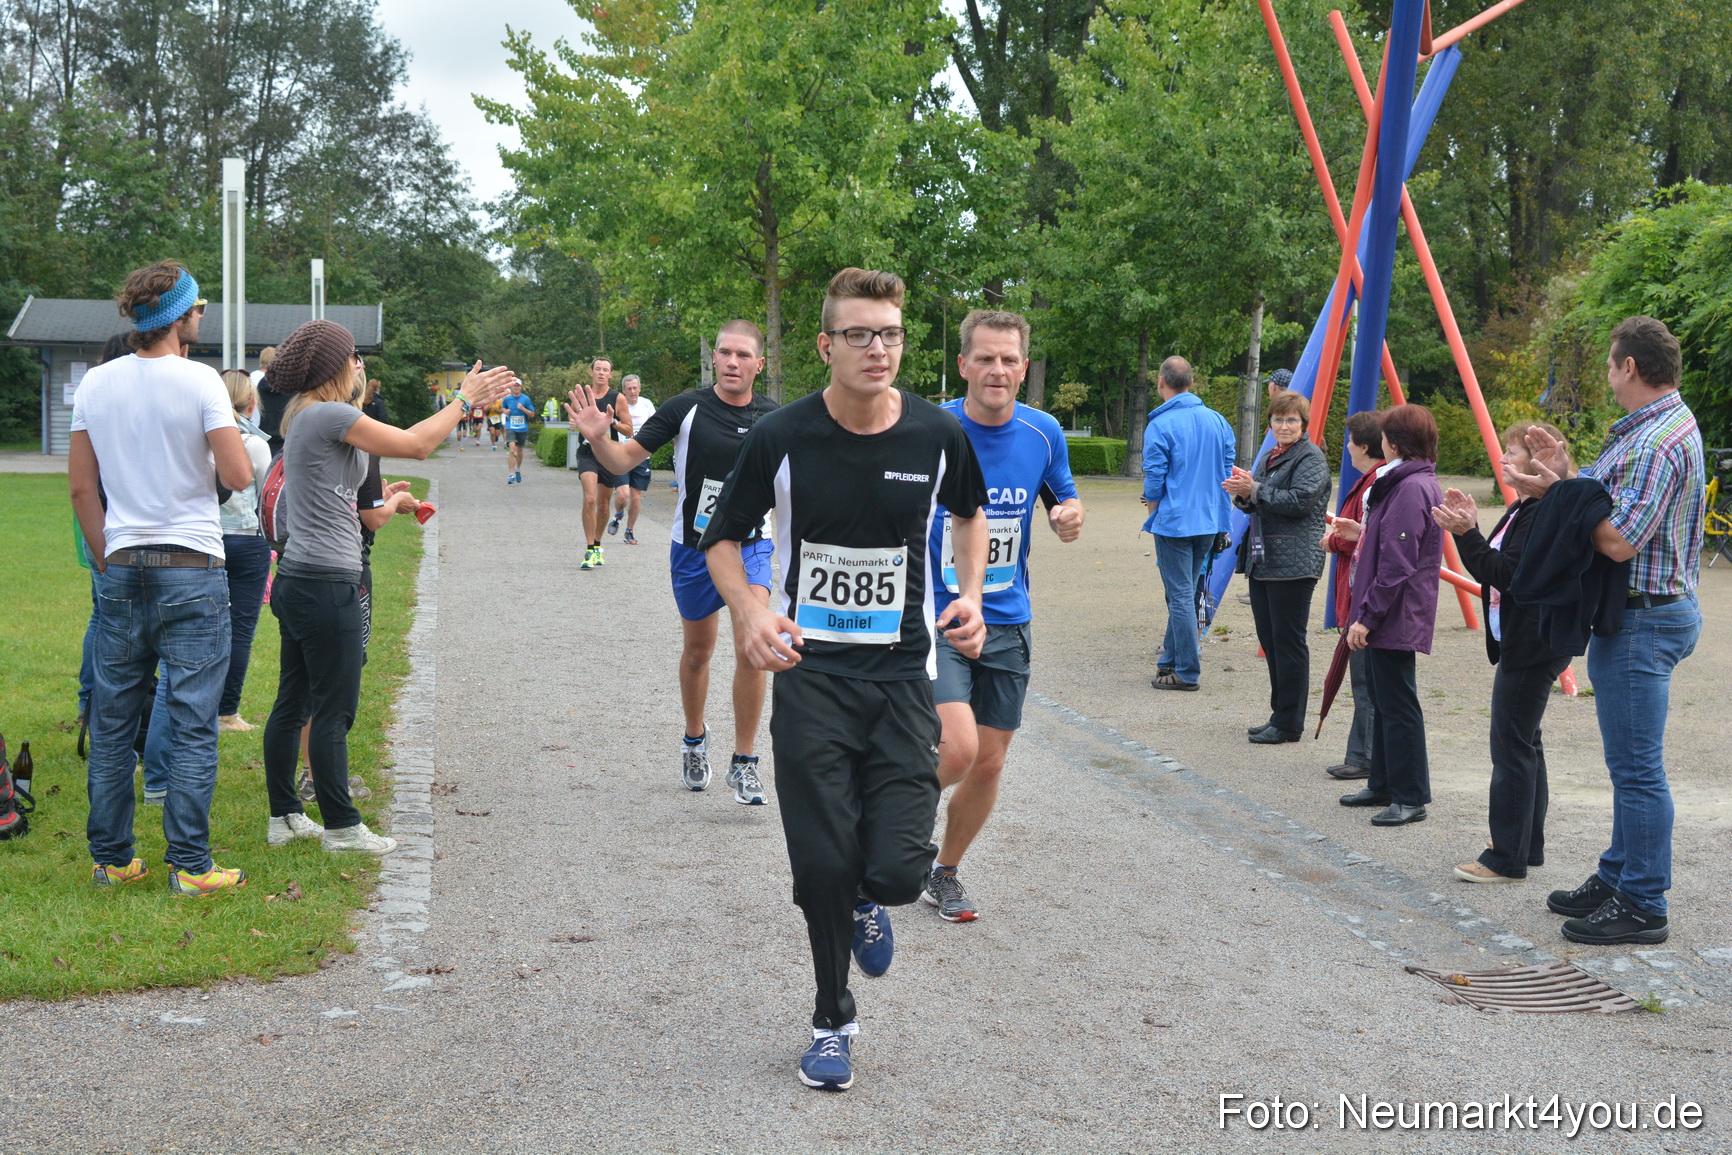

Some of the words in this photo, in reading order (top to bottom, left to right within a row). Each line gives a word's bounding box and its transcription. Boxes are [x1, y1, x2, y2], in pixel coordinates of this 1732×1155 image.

[891, 472, 930, 482] PFLEIDERER
[703, 484, 723, 493] PART
[987, 488, 1028, 505] CAD
[803, 551, 835, 564] PARTL
[838, 556, 889, 567] Neumarkt
[809, 567, 895, 606] 2685
[827, 613, 872, 629] Daniel
